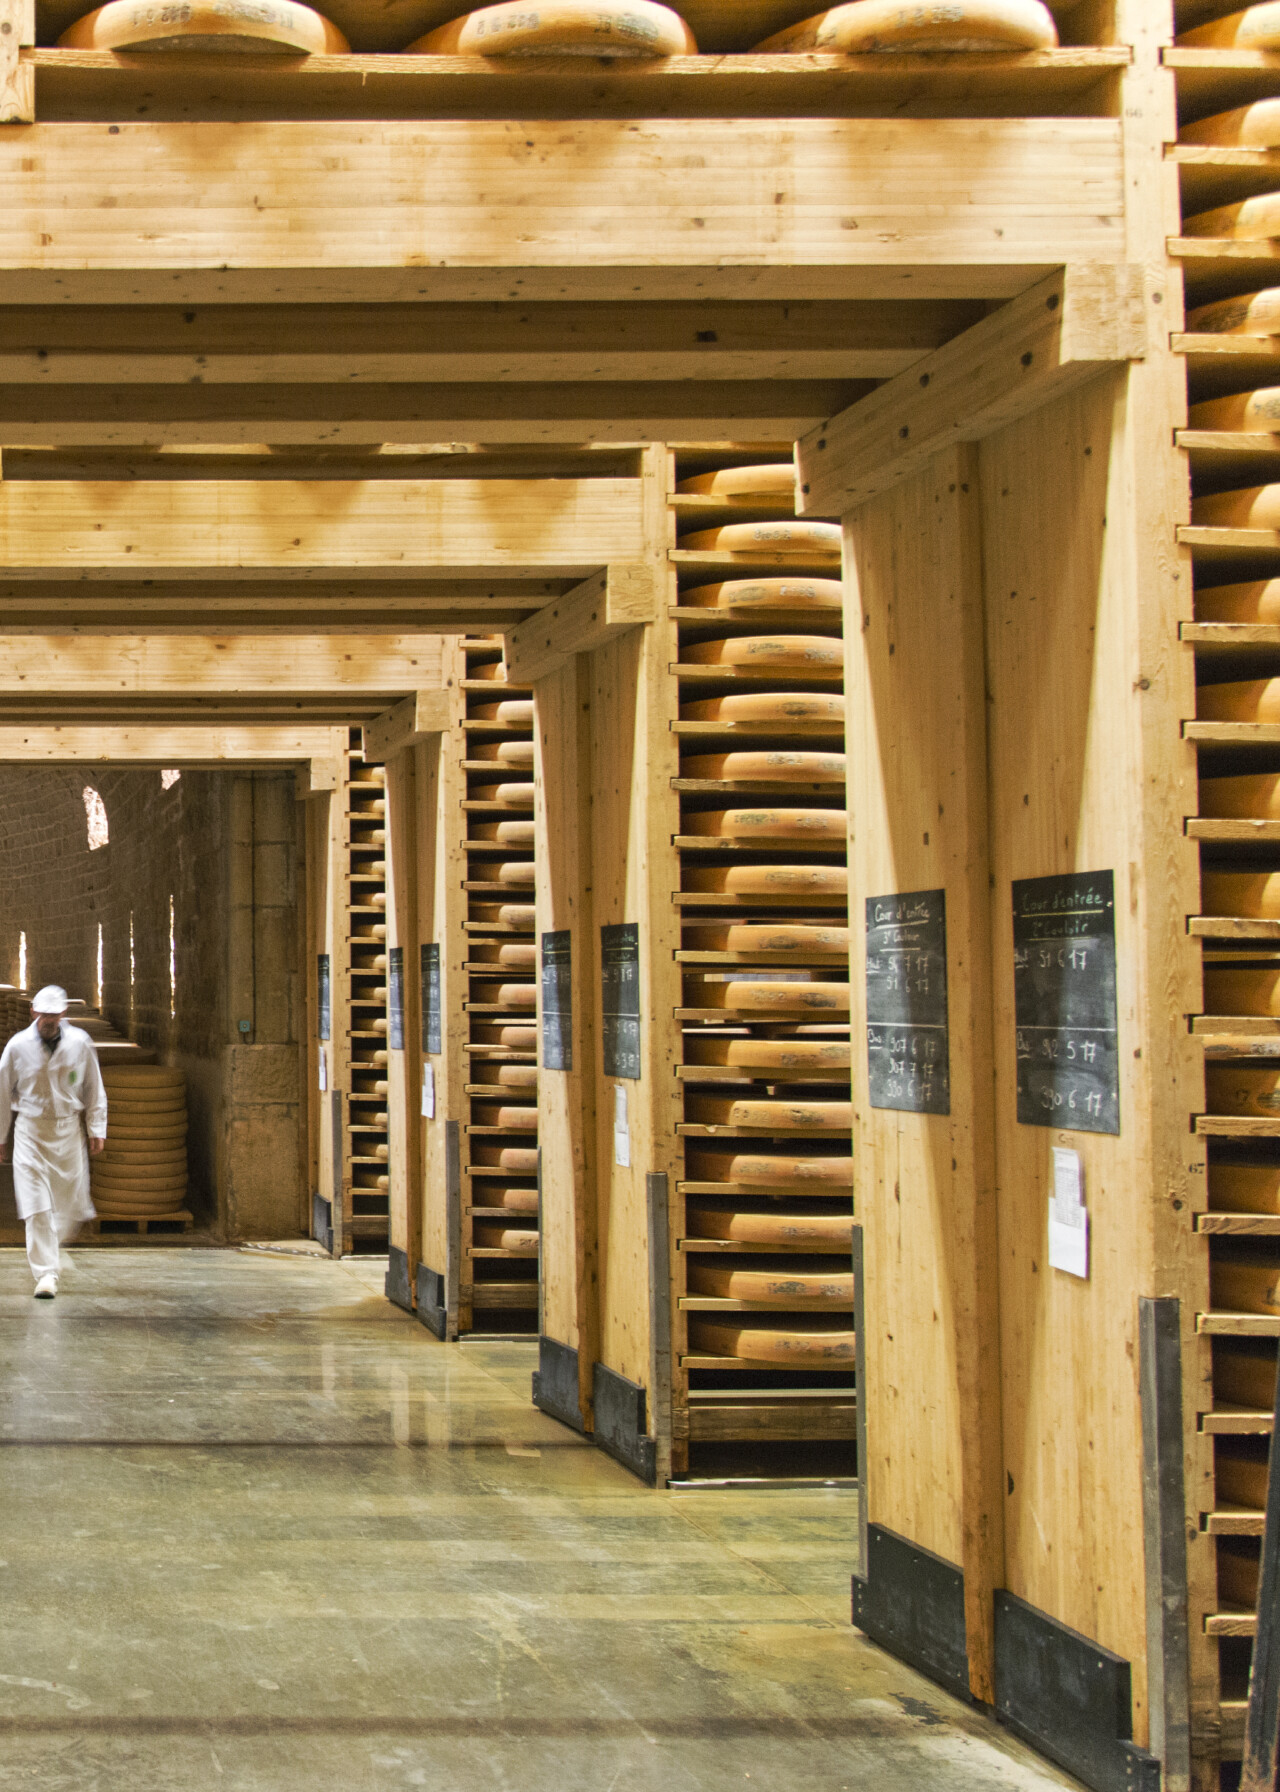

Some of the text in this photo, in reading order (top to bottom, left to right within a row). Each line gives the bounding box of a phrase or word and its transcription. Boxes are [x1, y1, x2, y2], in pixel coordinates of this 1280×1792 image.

[915, 956, 929, 975] 17
[1068, 949, 1087, 971] 17
[915, 978, 929, 995] 17
[1066, 1041, 1076, 1060] 5
[1080, 1040, 1097, 1064] 17
[909, 1062, 917, 1078] 7
[922, 1063, 934, 1079] 17
[907, 1080, 914, 1097] 6
[919, 1083, 932, 1101] 17
[1068, 1089, 1078, 1109] 6
[1085, 1091, 1102, 1117] 17
